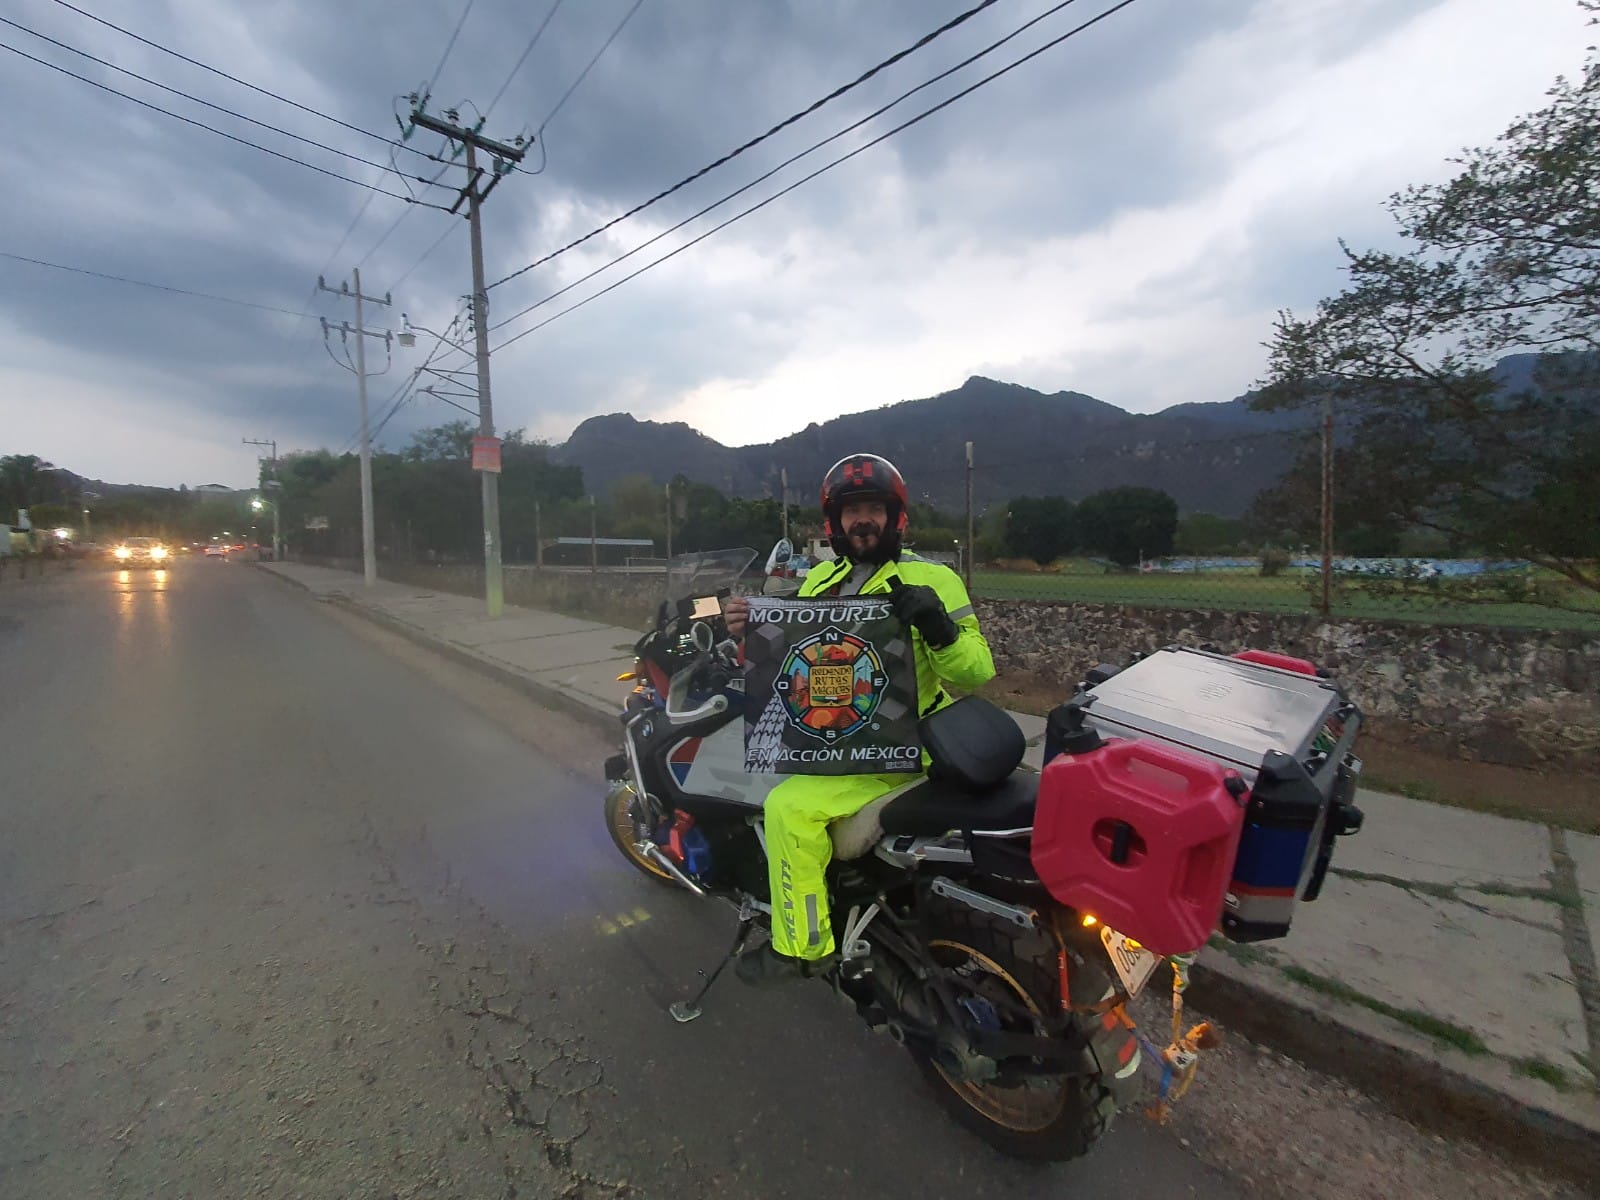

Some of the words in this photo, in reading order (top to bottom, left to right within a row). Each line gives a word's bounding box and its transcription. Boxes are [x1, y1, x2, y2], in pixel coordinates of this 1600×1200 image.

[826, 633, 838, 641] N
[874, 678, 884, 686] E
[826, 731, 836, 739] S
[747, 748, 772, 761] EN
[777, 746, 844, 761] ACCIÓN
[850, 745, 919, 760] MÉXICO
